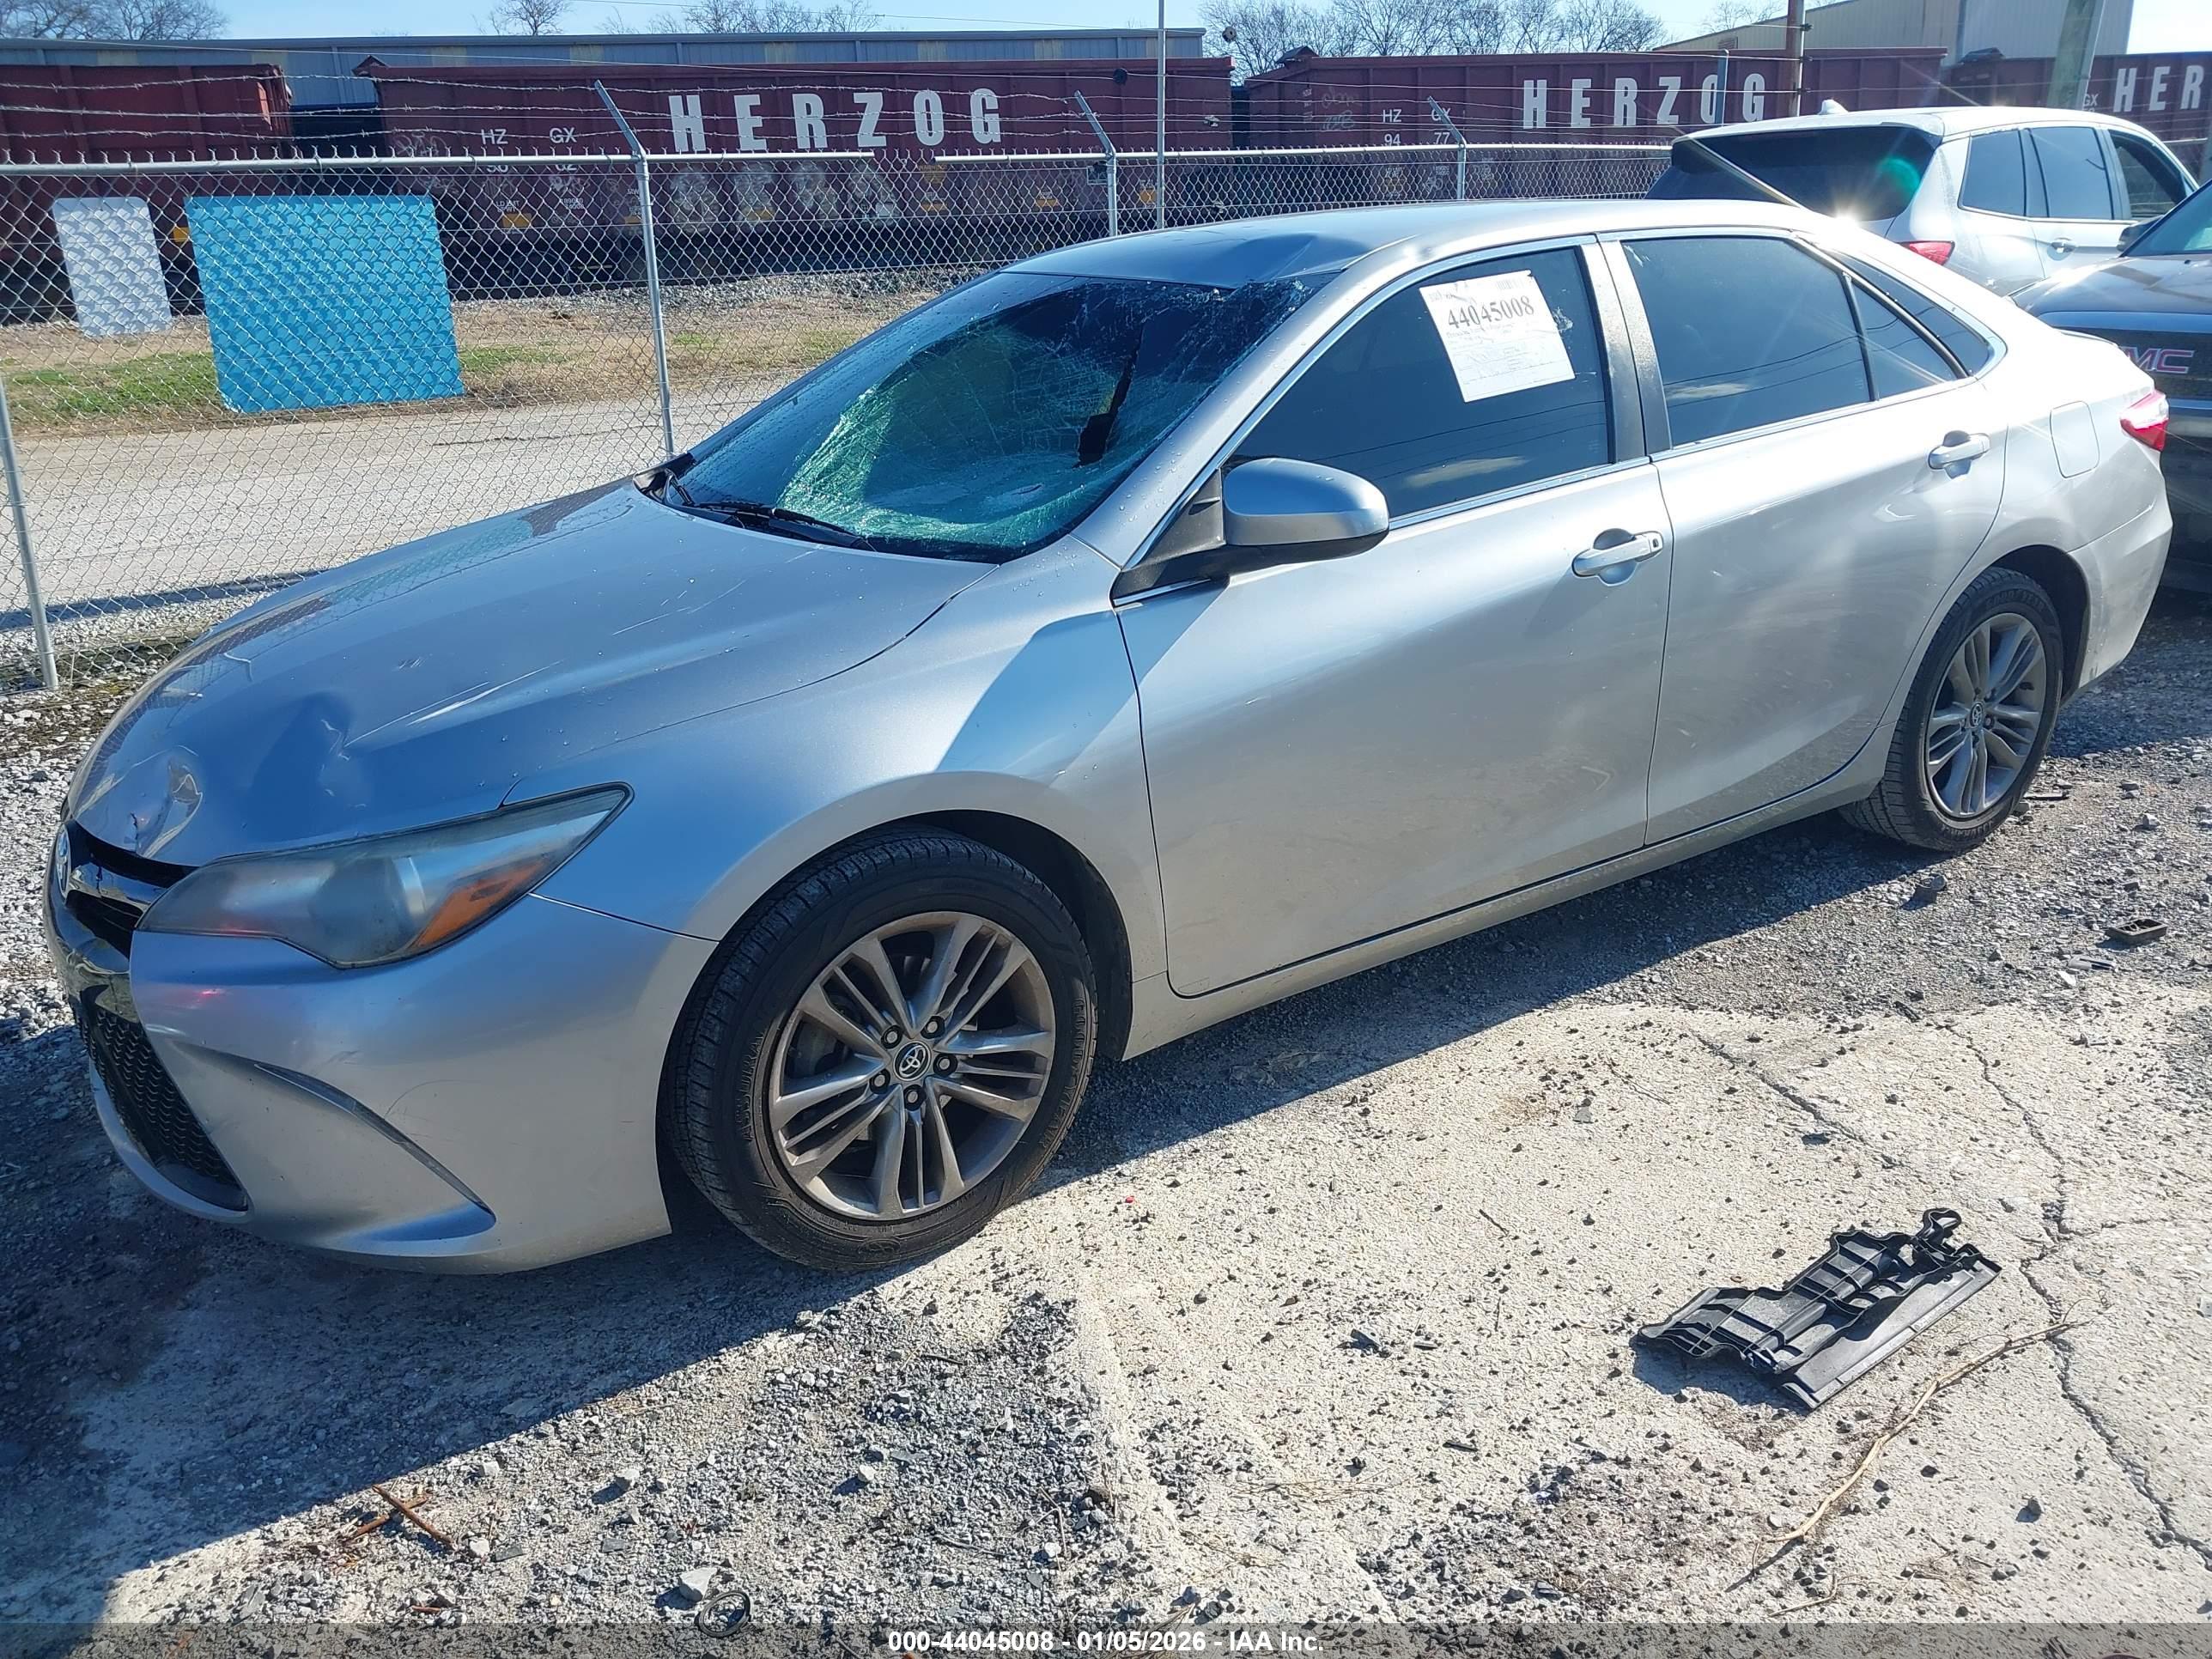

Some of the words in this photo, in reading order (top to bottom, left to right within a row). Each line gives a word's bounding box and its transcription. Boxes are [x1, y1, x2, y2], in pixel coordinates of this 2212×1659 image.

[1523, 73, 1765, 129] HERZOG
[668, 88, 1002, 152] HERZOG
[1382, 109, 1401, 122] HZ
[481, 129, 508, 144] HZ
[550, 127, 577, 143] GX
[1384, 133, 1401, 145] 94
[1434, 131, 1450, 144] 77
[1448, 295, 1534, 328] 44045008
